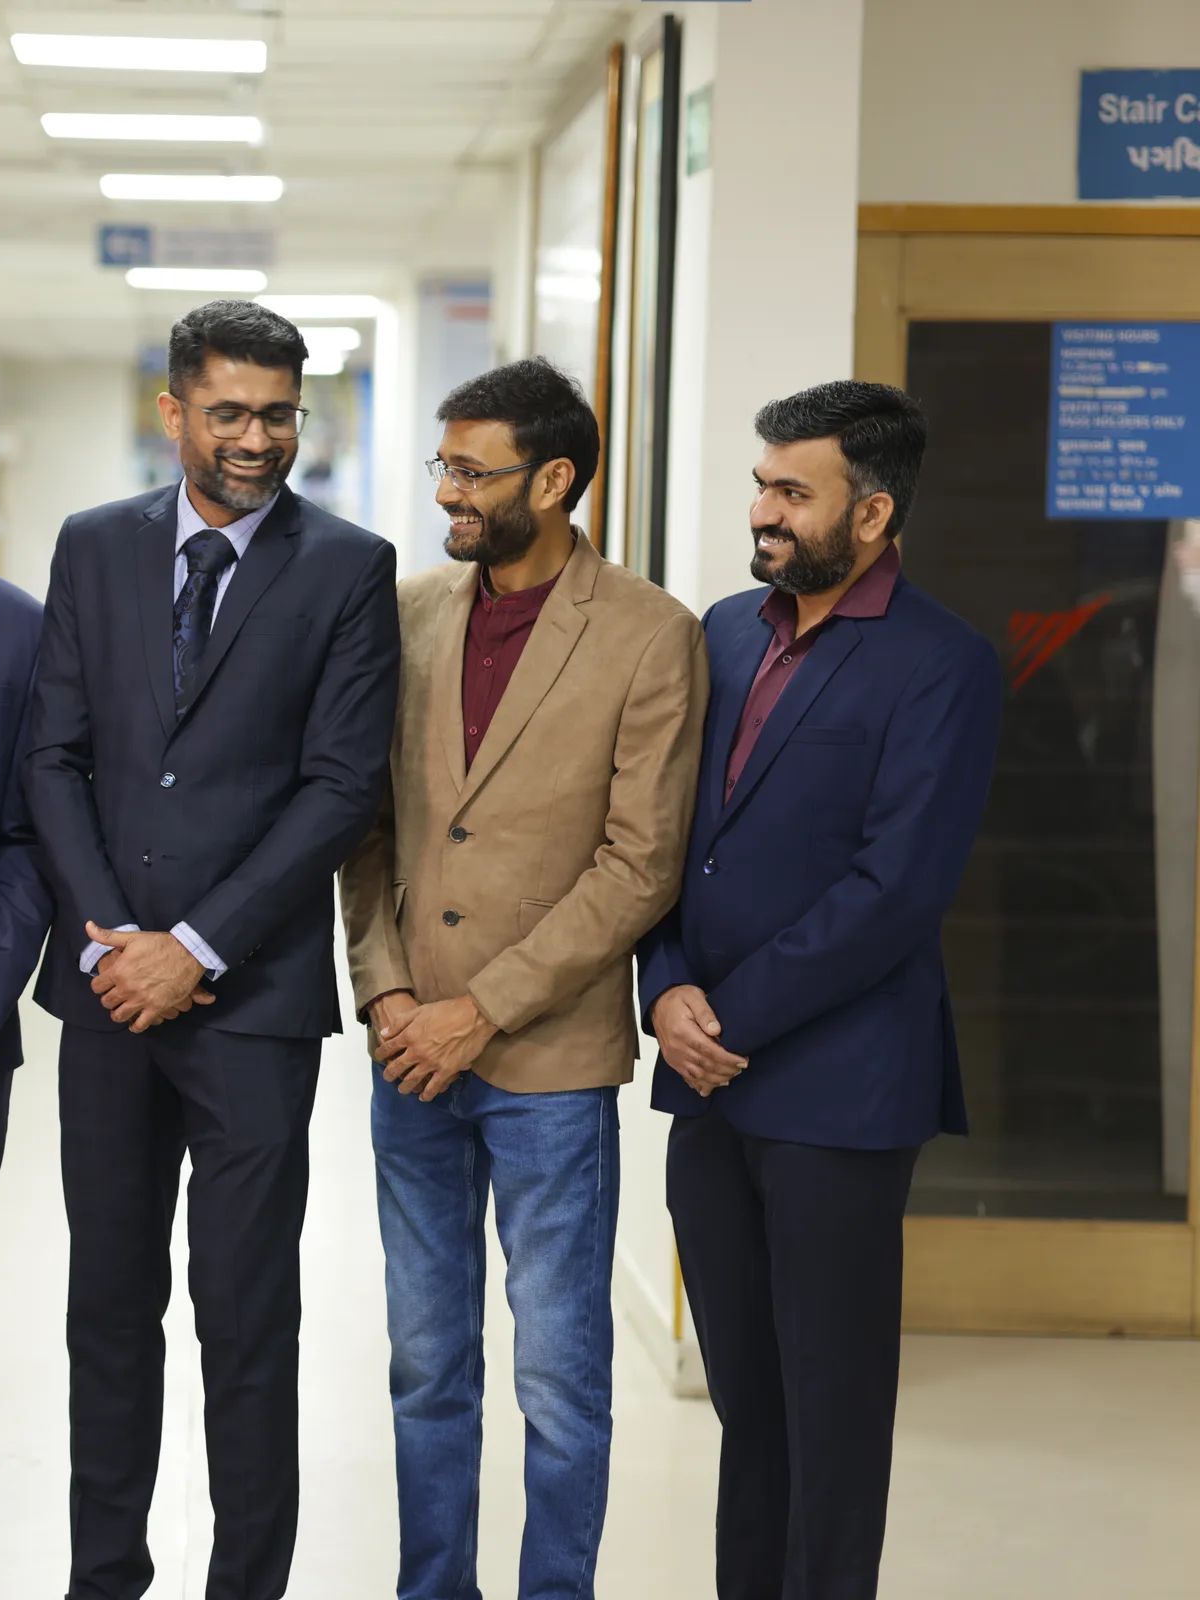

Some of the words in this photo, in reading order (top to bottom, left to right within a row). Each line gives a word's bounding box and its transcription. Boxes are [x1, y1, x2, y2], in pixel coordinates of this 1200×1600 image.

[1098, 92, 1169, 124] Stair
[1174, 92, 1200, 124] C
[1062, 329, 1115, 343] VISITING
[1117, 329, 1160, 343] HOURS
[1152, 415, 1186, 430] ONLY
